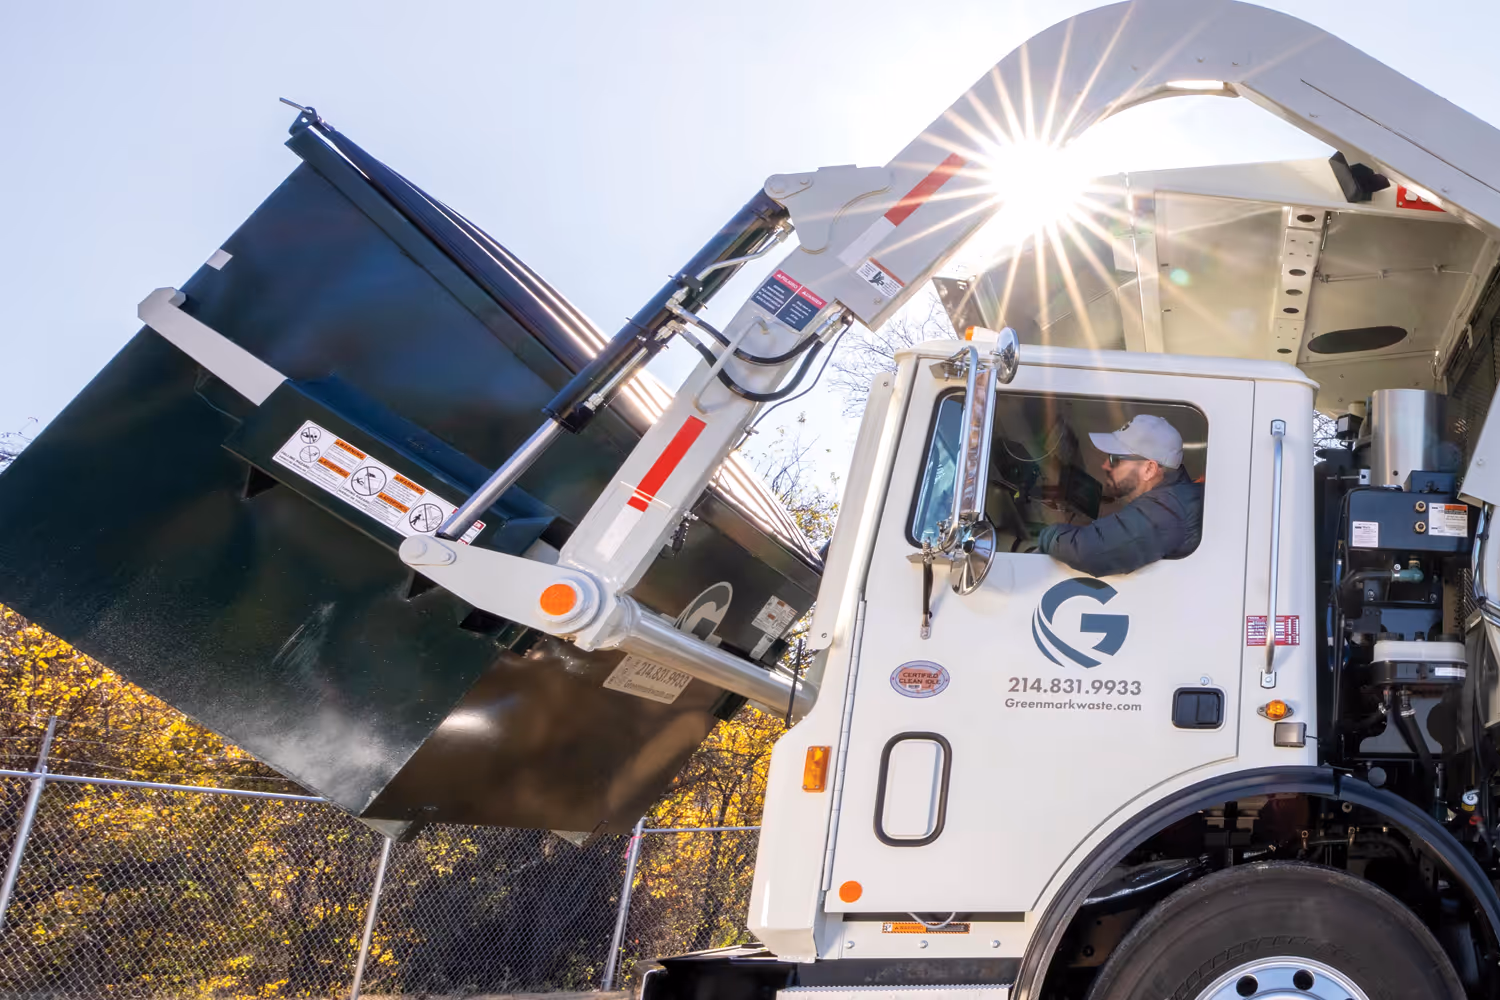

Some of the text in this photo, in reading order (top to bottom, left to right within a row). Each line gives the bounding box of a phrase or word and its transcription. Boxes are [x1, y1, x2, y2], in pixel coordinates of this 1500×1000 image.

[338, 441, 364, 459] WARNING
[397, 476, 424, 494] WARNING
[1032, 577, 1129, 669] G
[1008, 677, 1142, 696] 214.831.9933
[1005, 698, 1142, 711] Greenmarkwaste.com
